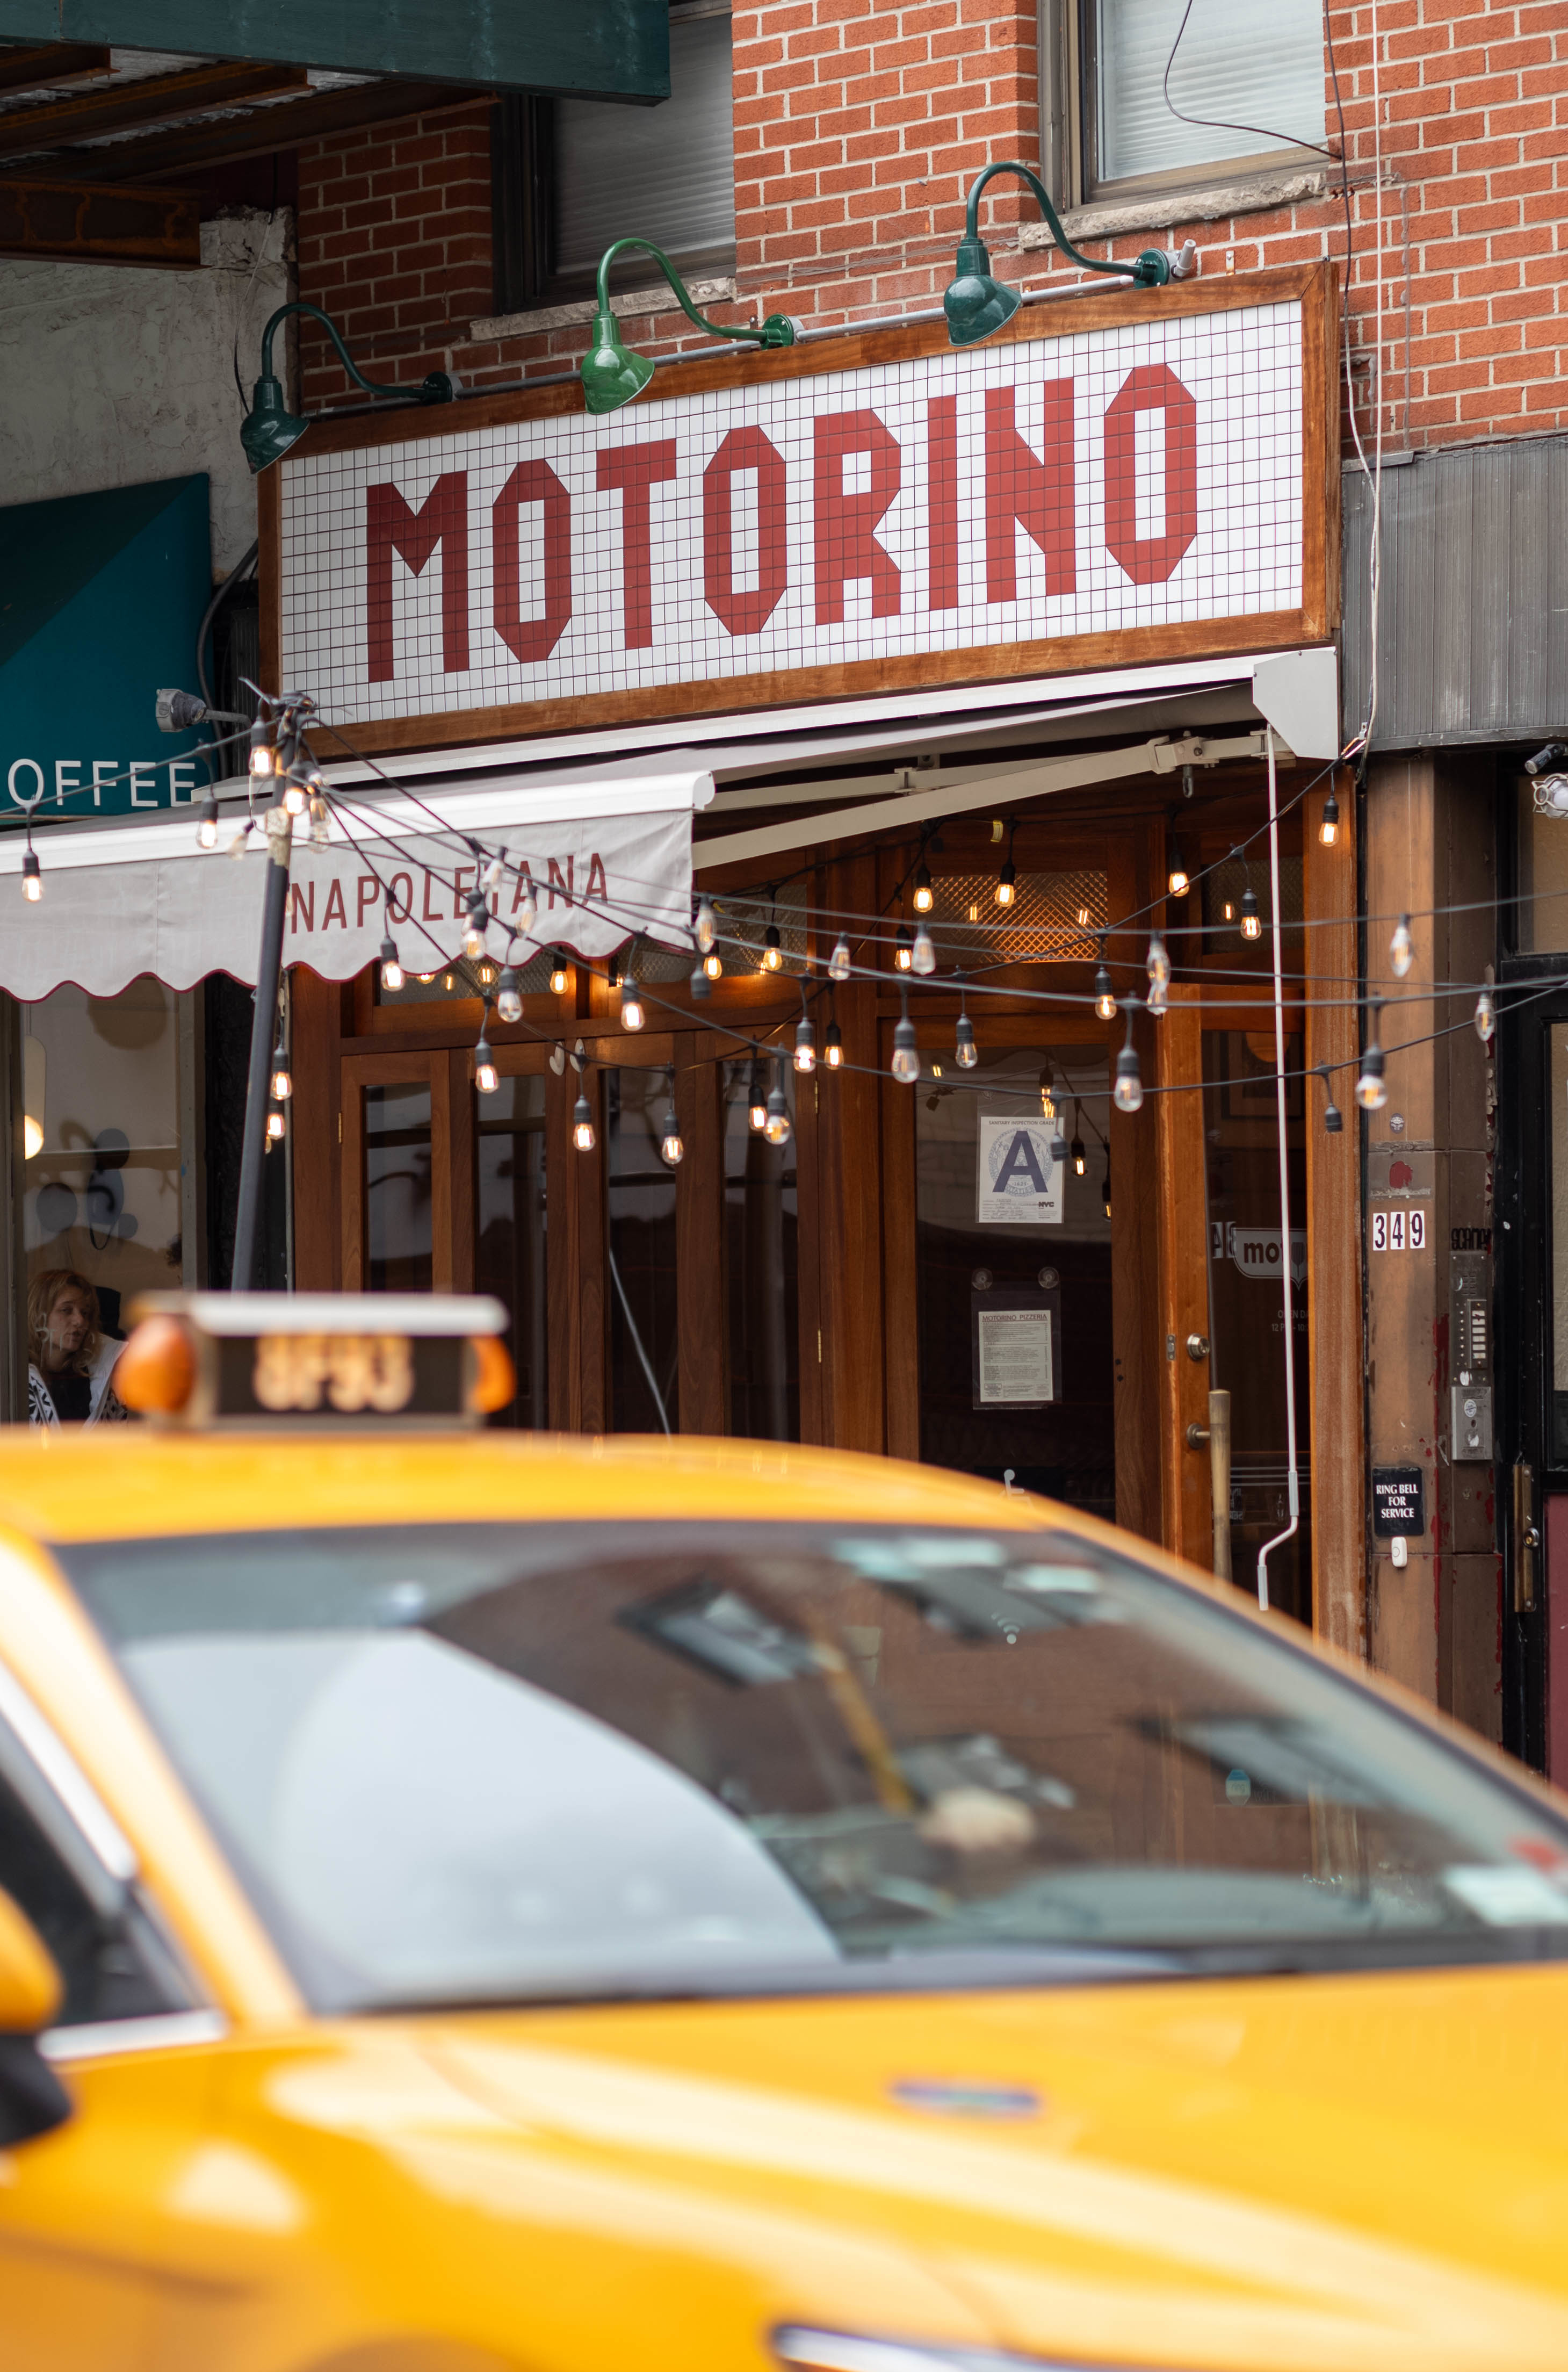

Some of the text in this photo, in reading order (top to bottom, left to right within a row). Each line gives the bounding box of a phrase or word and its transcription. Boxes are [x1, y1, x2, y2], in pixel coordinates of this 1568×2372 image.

[366, 363, 1197, 683] MOTORINO
[8, 758, 196, 807] OFFEE
[992, 1130, 1049, 1193] A
[1375, 1213, 1422, 1249] 349
[1376, 1483, 1419, 1494] RING BELL
[1388, 1496, 1406, 1506] FOR
[1381, 1508, 1414, 1518] SERVICE
